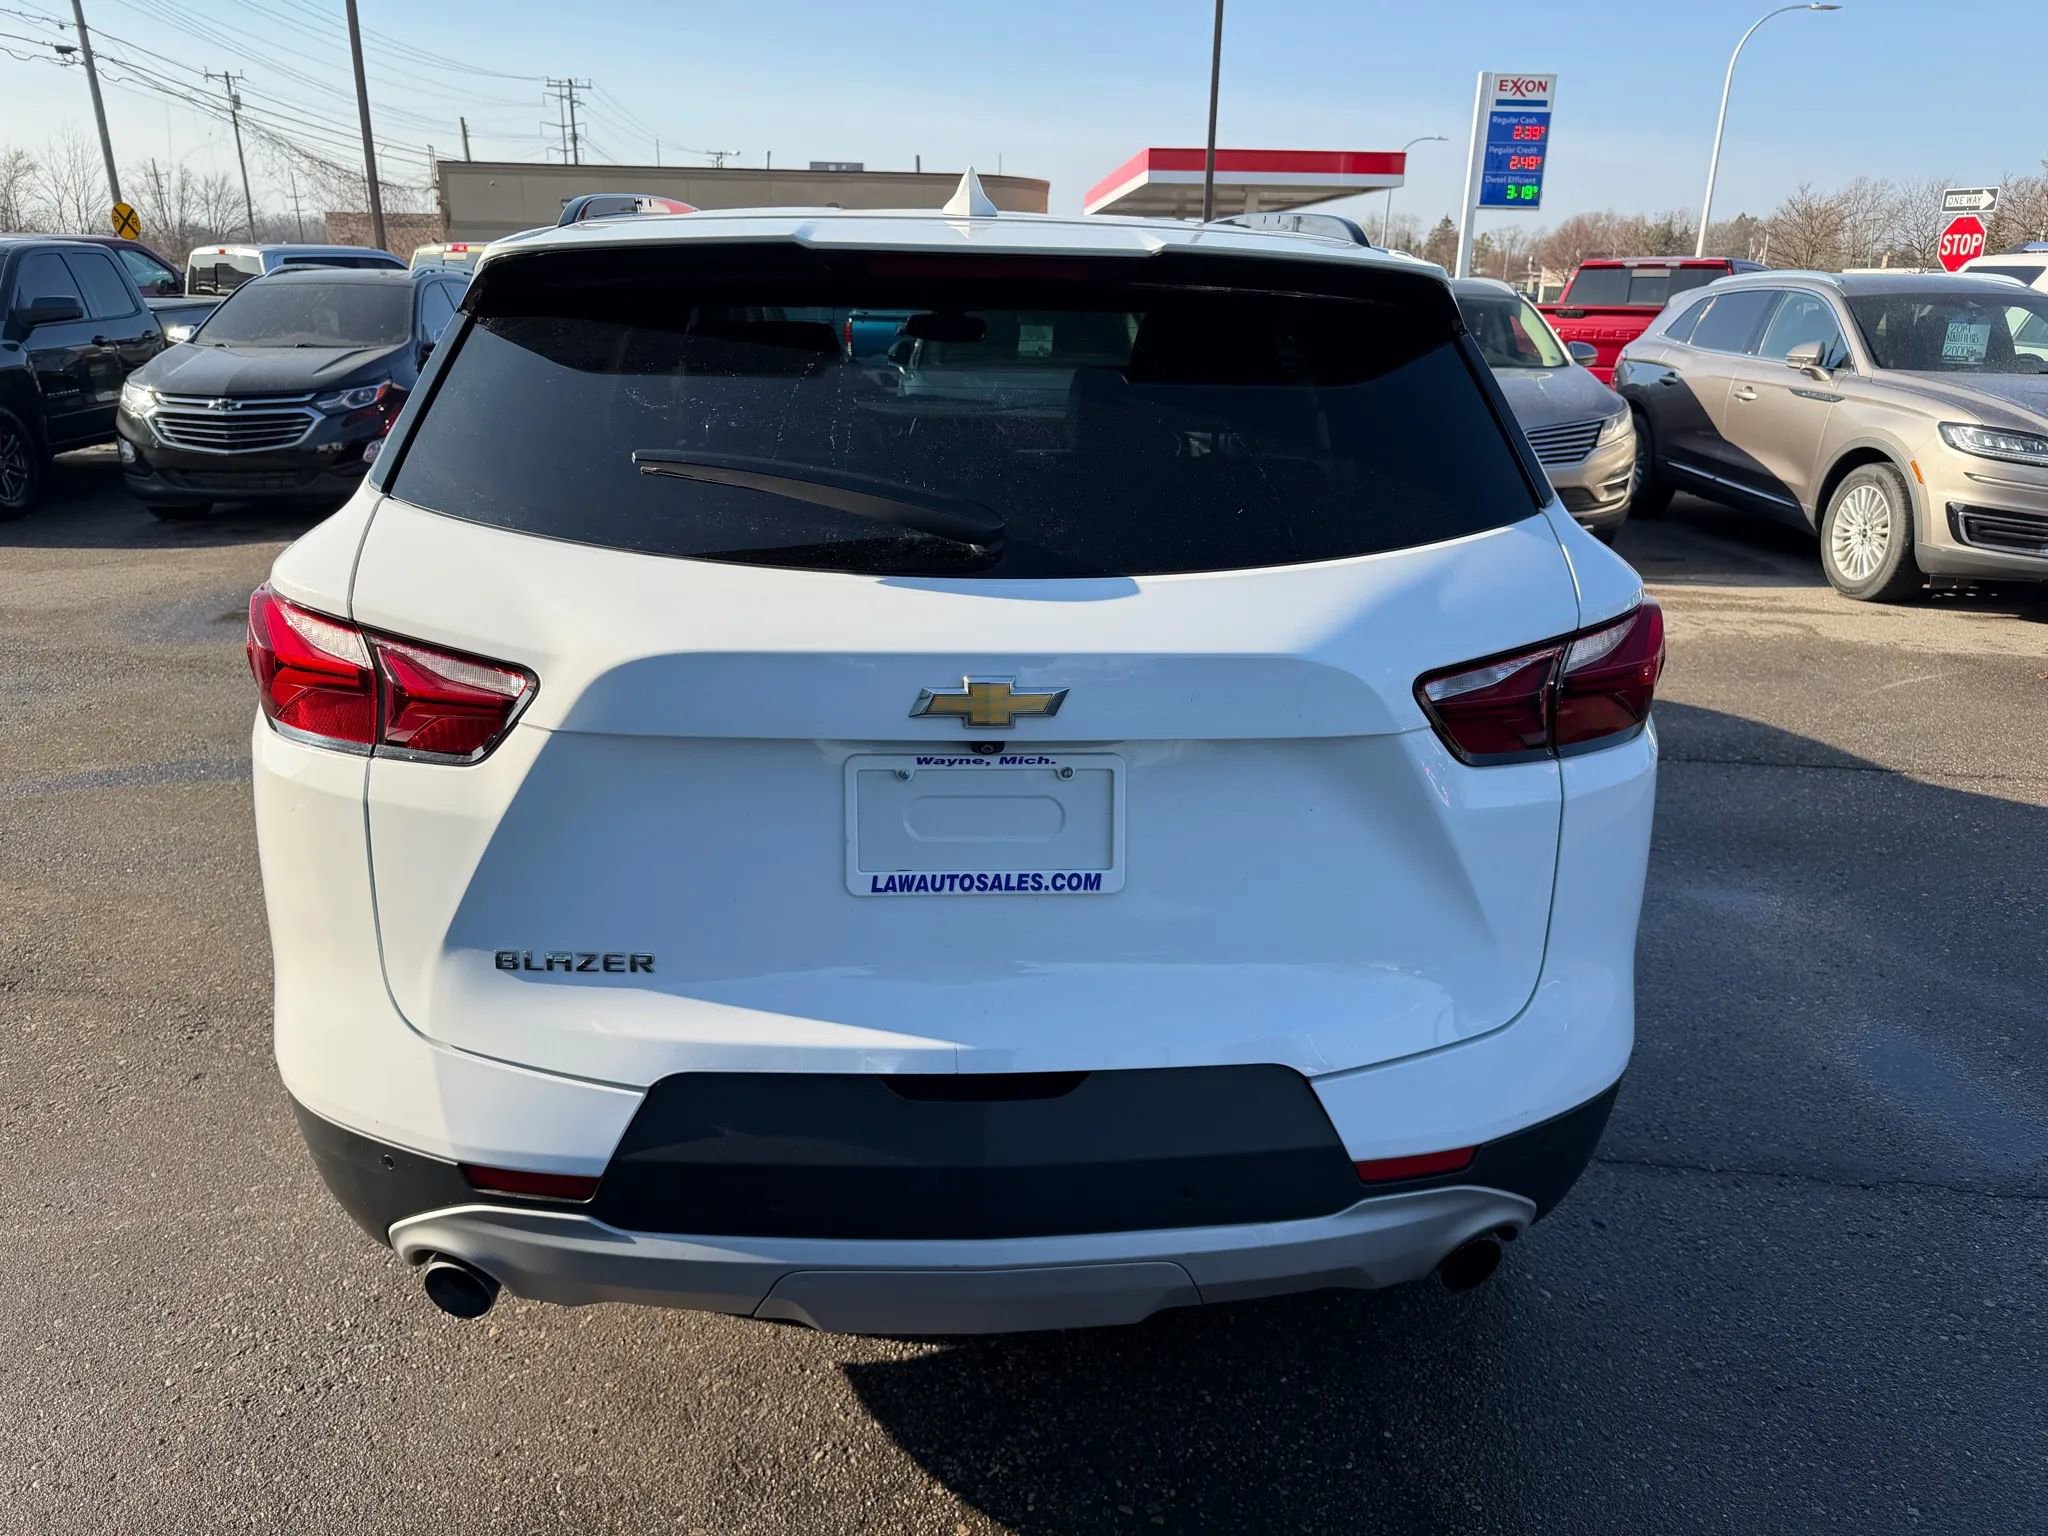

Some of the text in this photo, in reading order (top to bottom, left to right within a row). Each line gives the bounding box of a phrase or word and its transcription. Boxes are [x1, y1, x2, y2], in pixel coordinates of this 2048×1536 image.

[1498, 77, 1548, 98] EXXON
[1492, 116, 1537, 125] Regular Cash
[1488, 146, 1538, 155] Regular Credit
[1485, 176, 1537, 184] Diesel Efficient
[1947, 195, 1983, 206] ONE WAY
[1941, 234, 1983, 256] STOP
[916, 756, 1056, 767] Wayne, Mich.
[870, 872, 1103, 894] LAWAUTOSALES.COM
[494, 950, 656, 974] BLAZER
